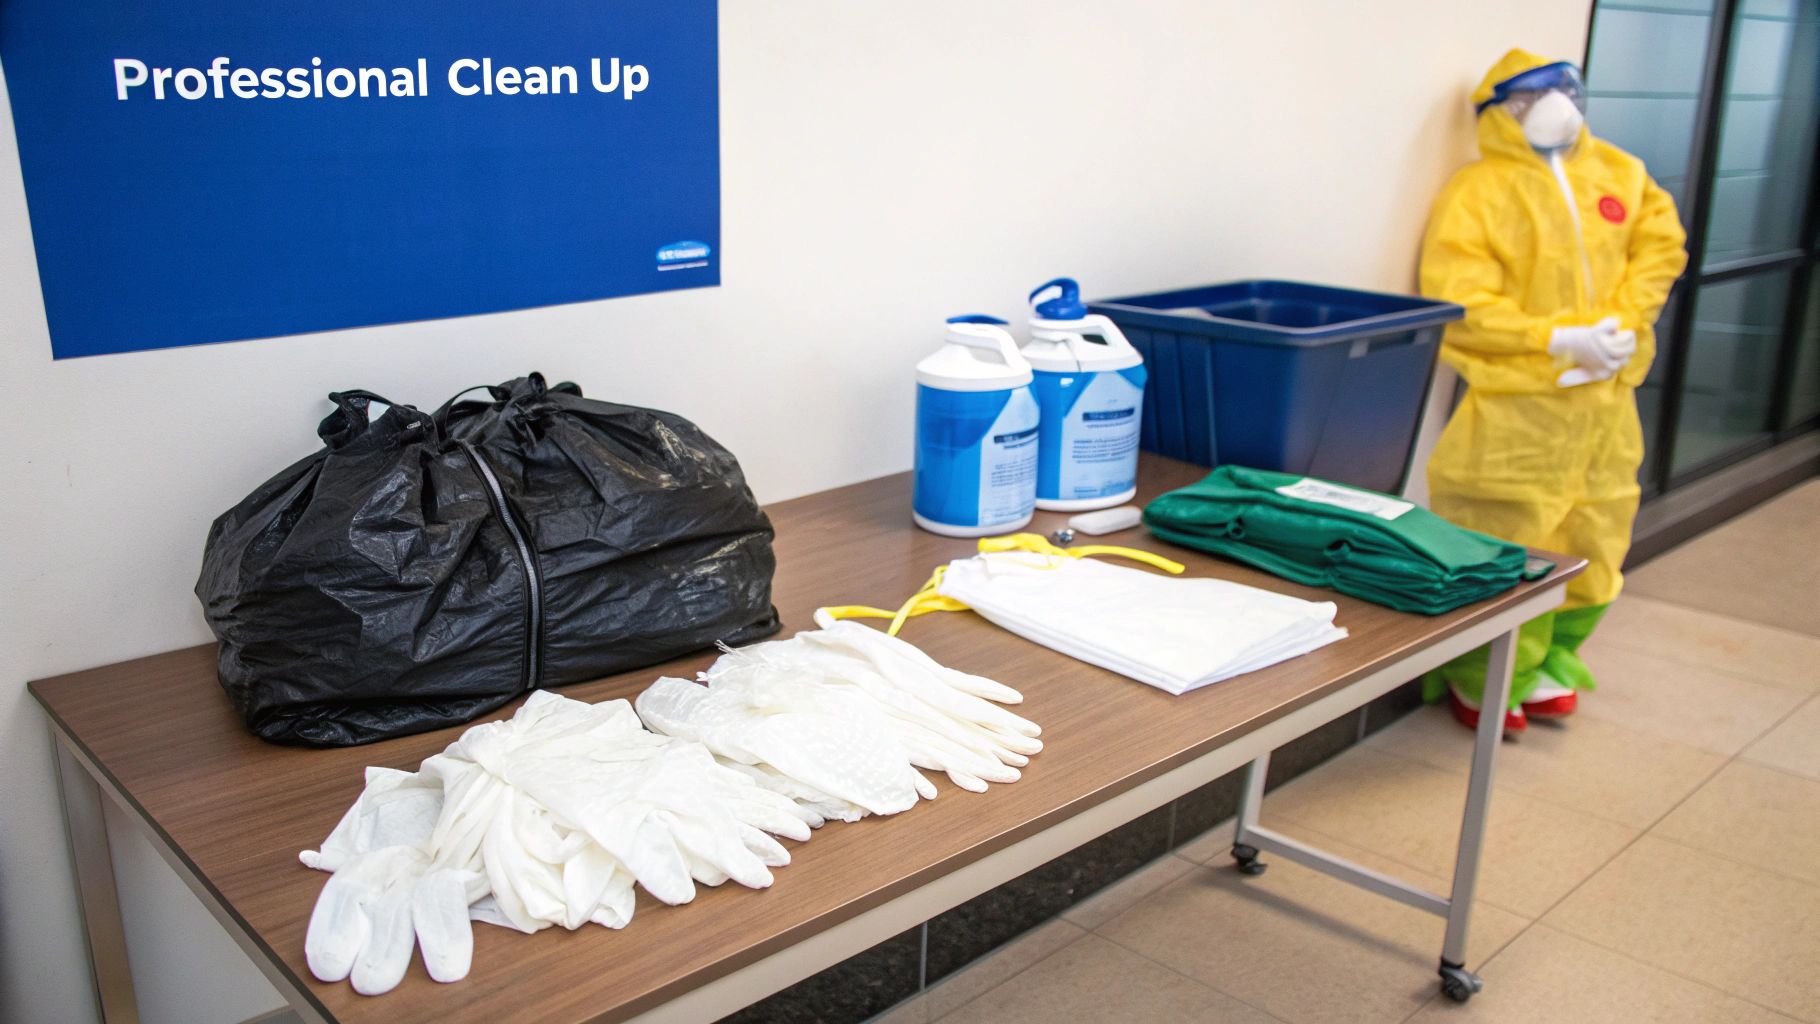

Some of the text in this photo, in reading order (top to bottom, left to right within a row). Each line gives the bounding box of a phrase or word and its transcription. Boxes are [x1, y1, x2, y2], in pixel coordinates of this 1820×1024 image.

[113, 57, 650, 101] Professional Clean Up
